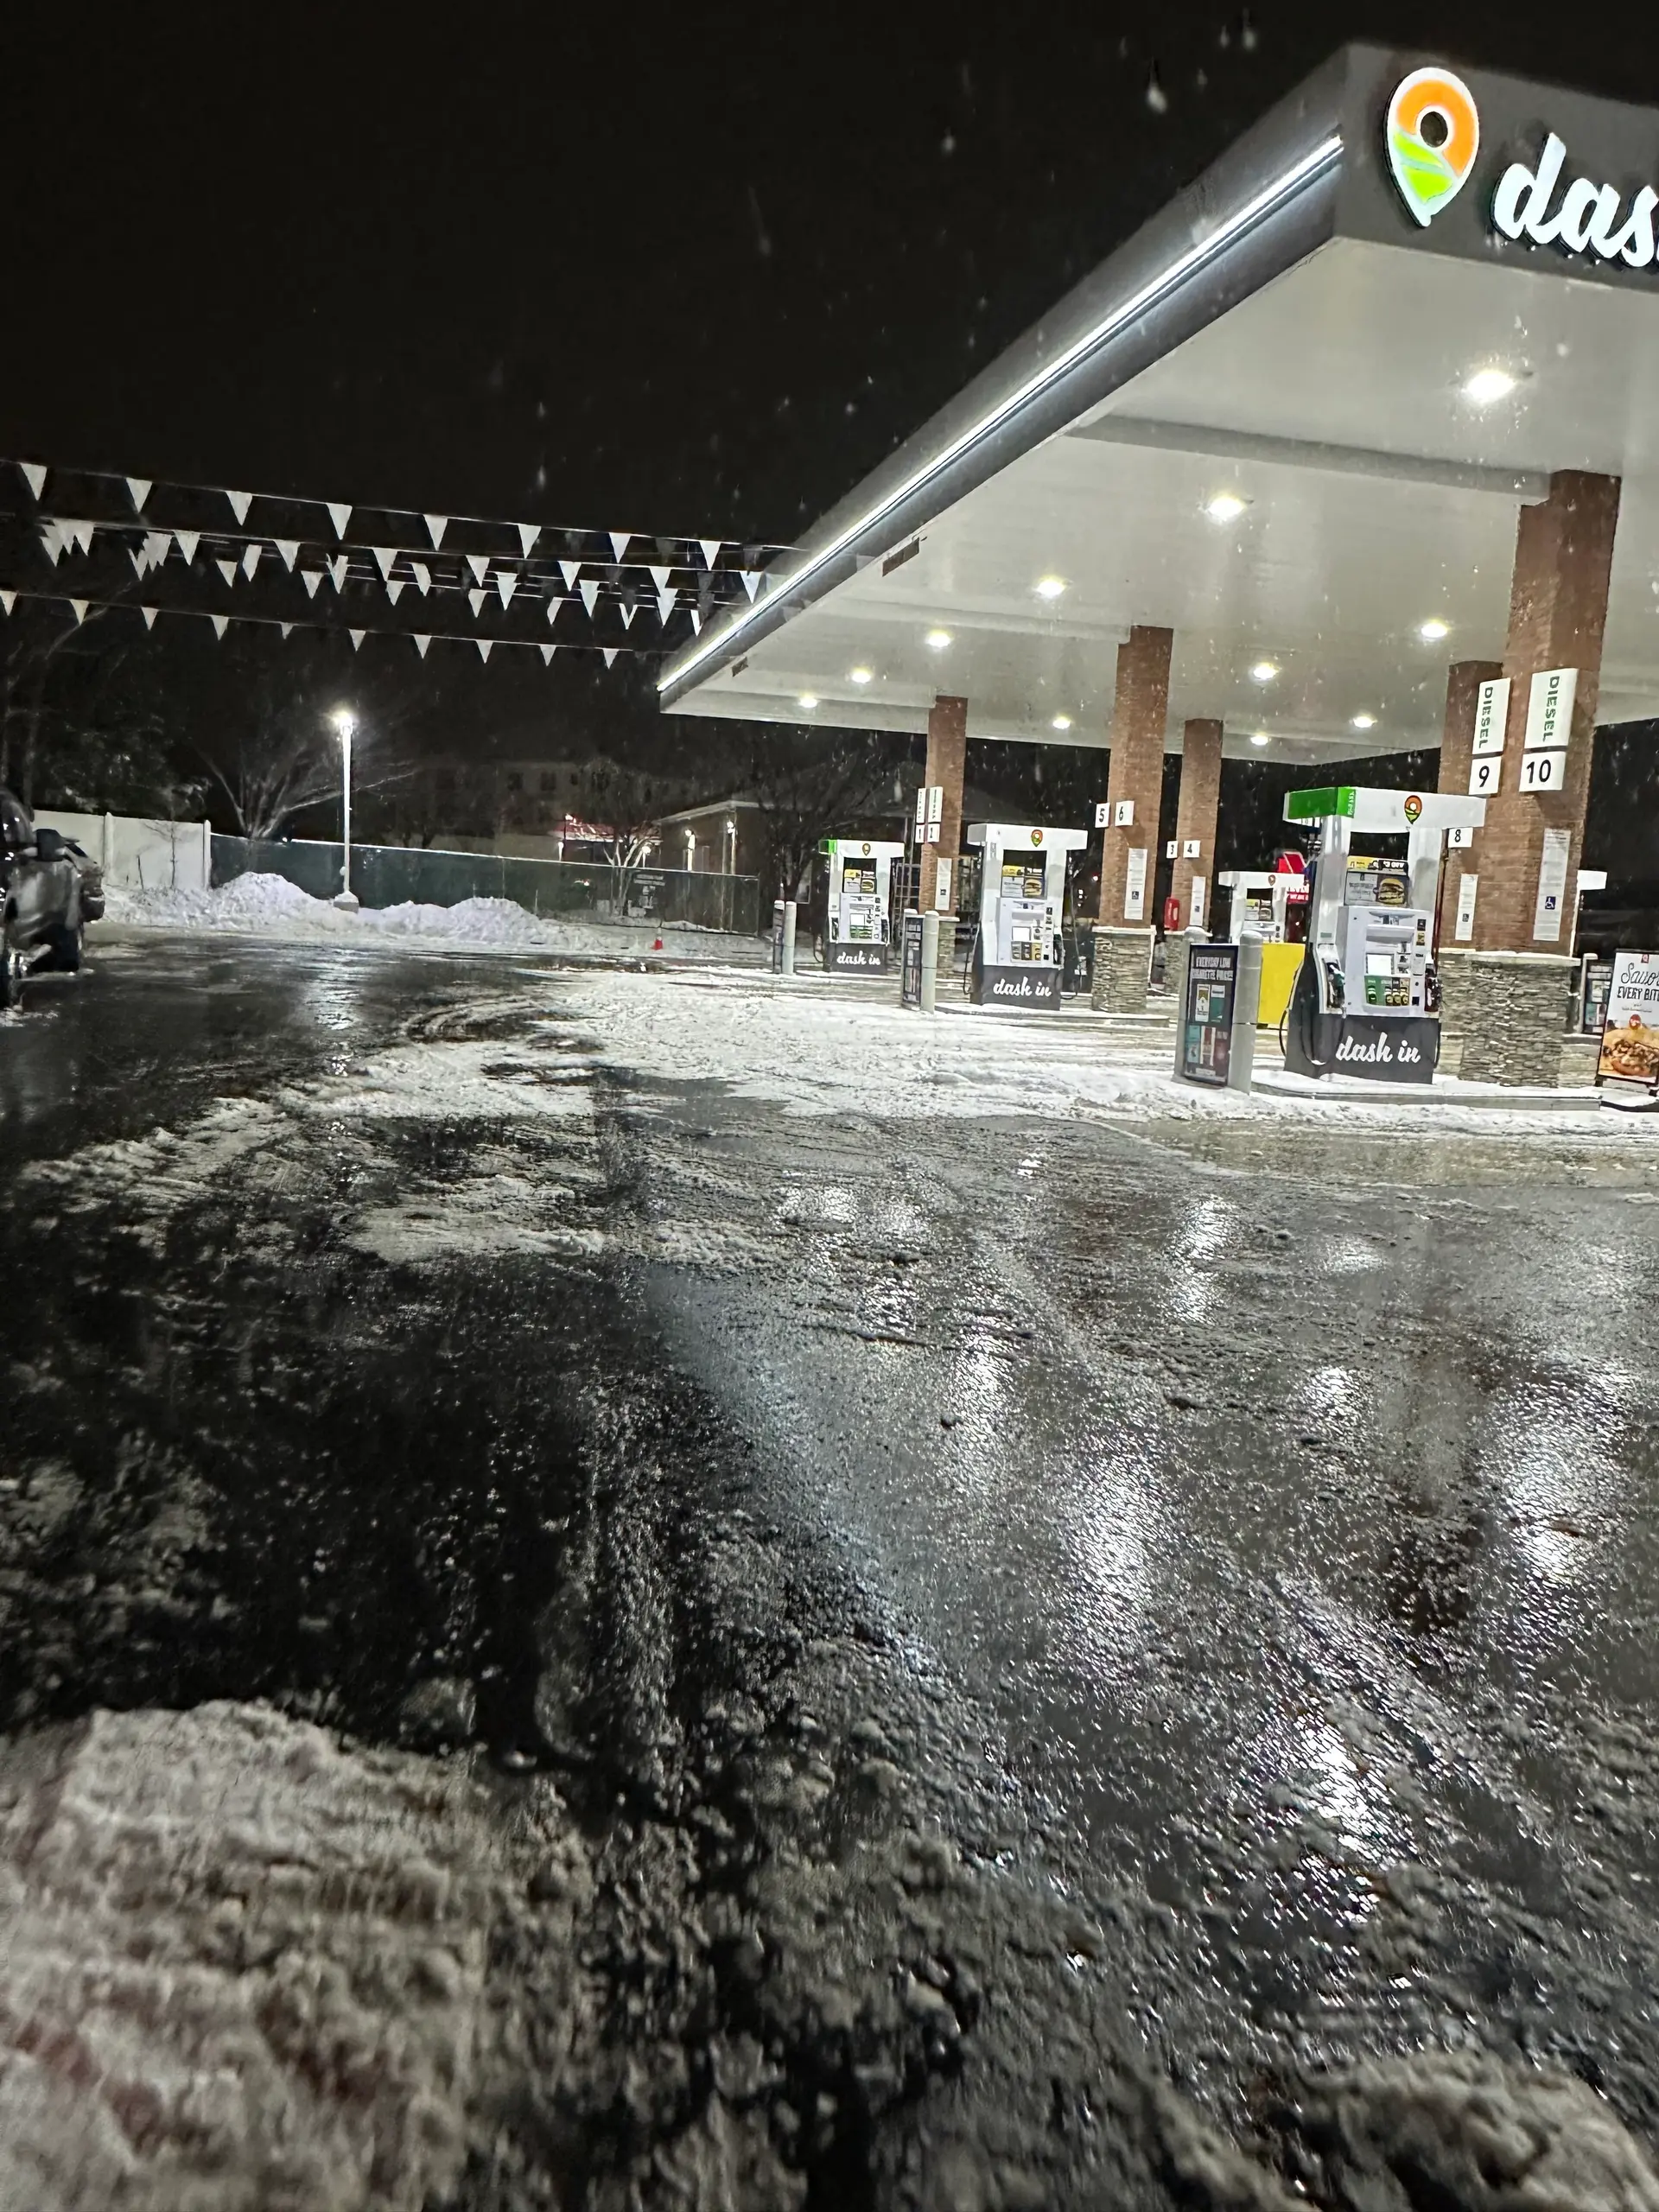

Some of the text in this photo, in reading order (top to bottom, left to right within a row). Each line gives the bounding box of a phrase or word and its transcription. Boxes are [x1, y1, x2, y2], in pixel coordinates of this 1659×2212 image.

[1491, 131, 1659, 268] das
[1478, 686, 1494, 749] DIESEL
[1542, 676, 1560, 742] DIESEL
[1478, 765, 1491, 788] 9
[1526, 759, 1552, 784] 10
[1098, 808, 1106, 823] 5
[1118, 806, 1124, 822] 6
[1454, 829, 1462, 843] 8
[1170, 844, 1175, 855] 3
[1186, 843, 1193, 854] 4
[836, 950, 881, 966] dash in
[993, 976, 1052, 997] dash in
[1617, 986, 1643, 1000] EVERY
[1335, 1032, 1421, 1064] dash in
